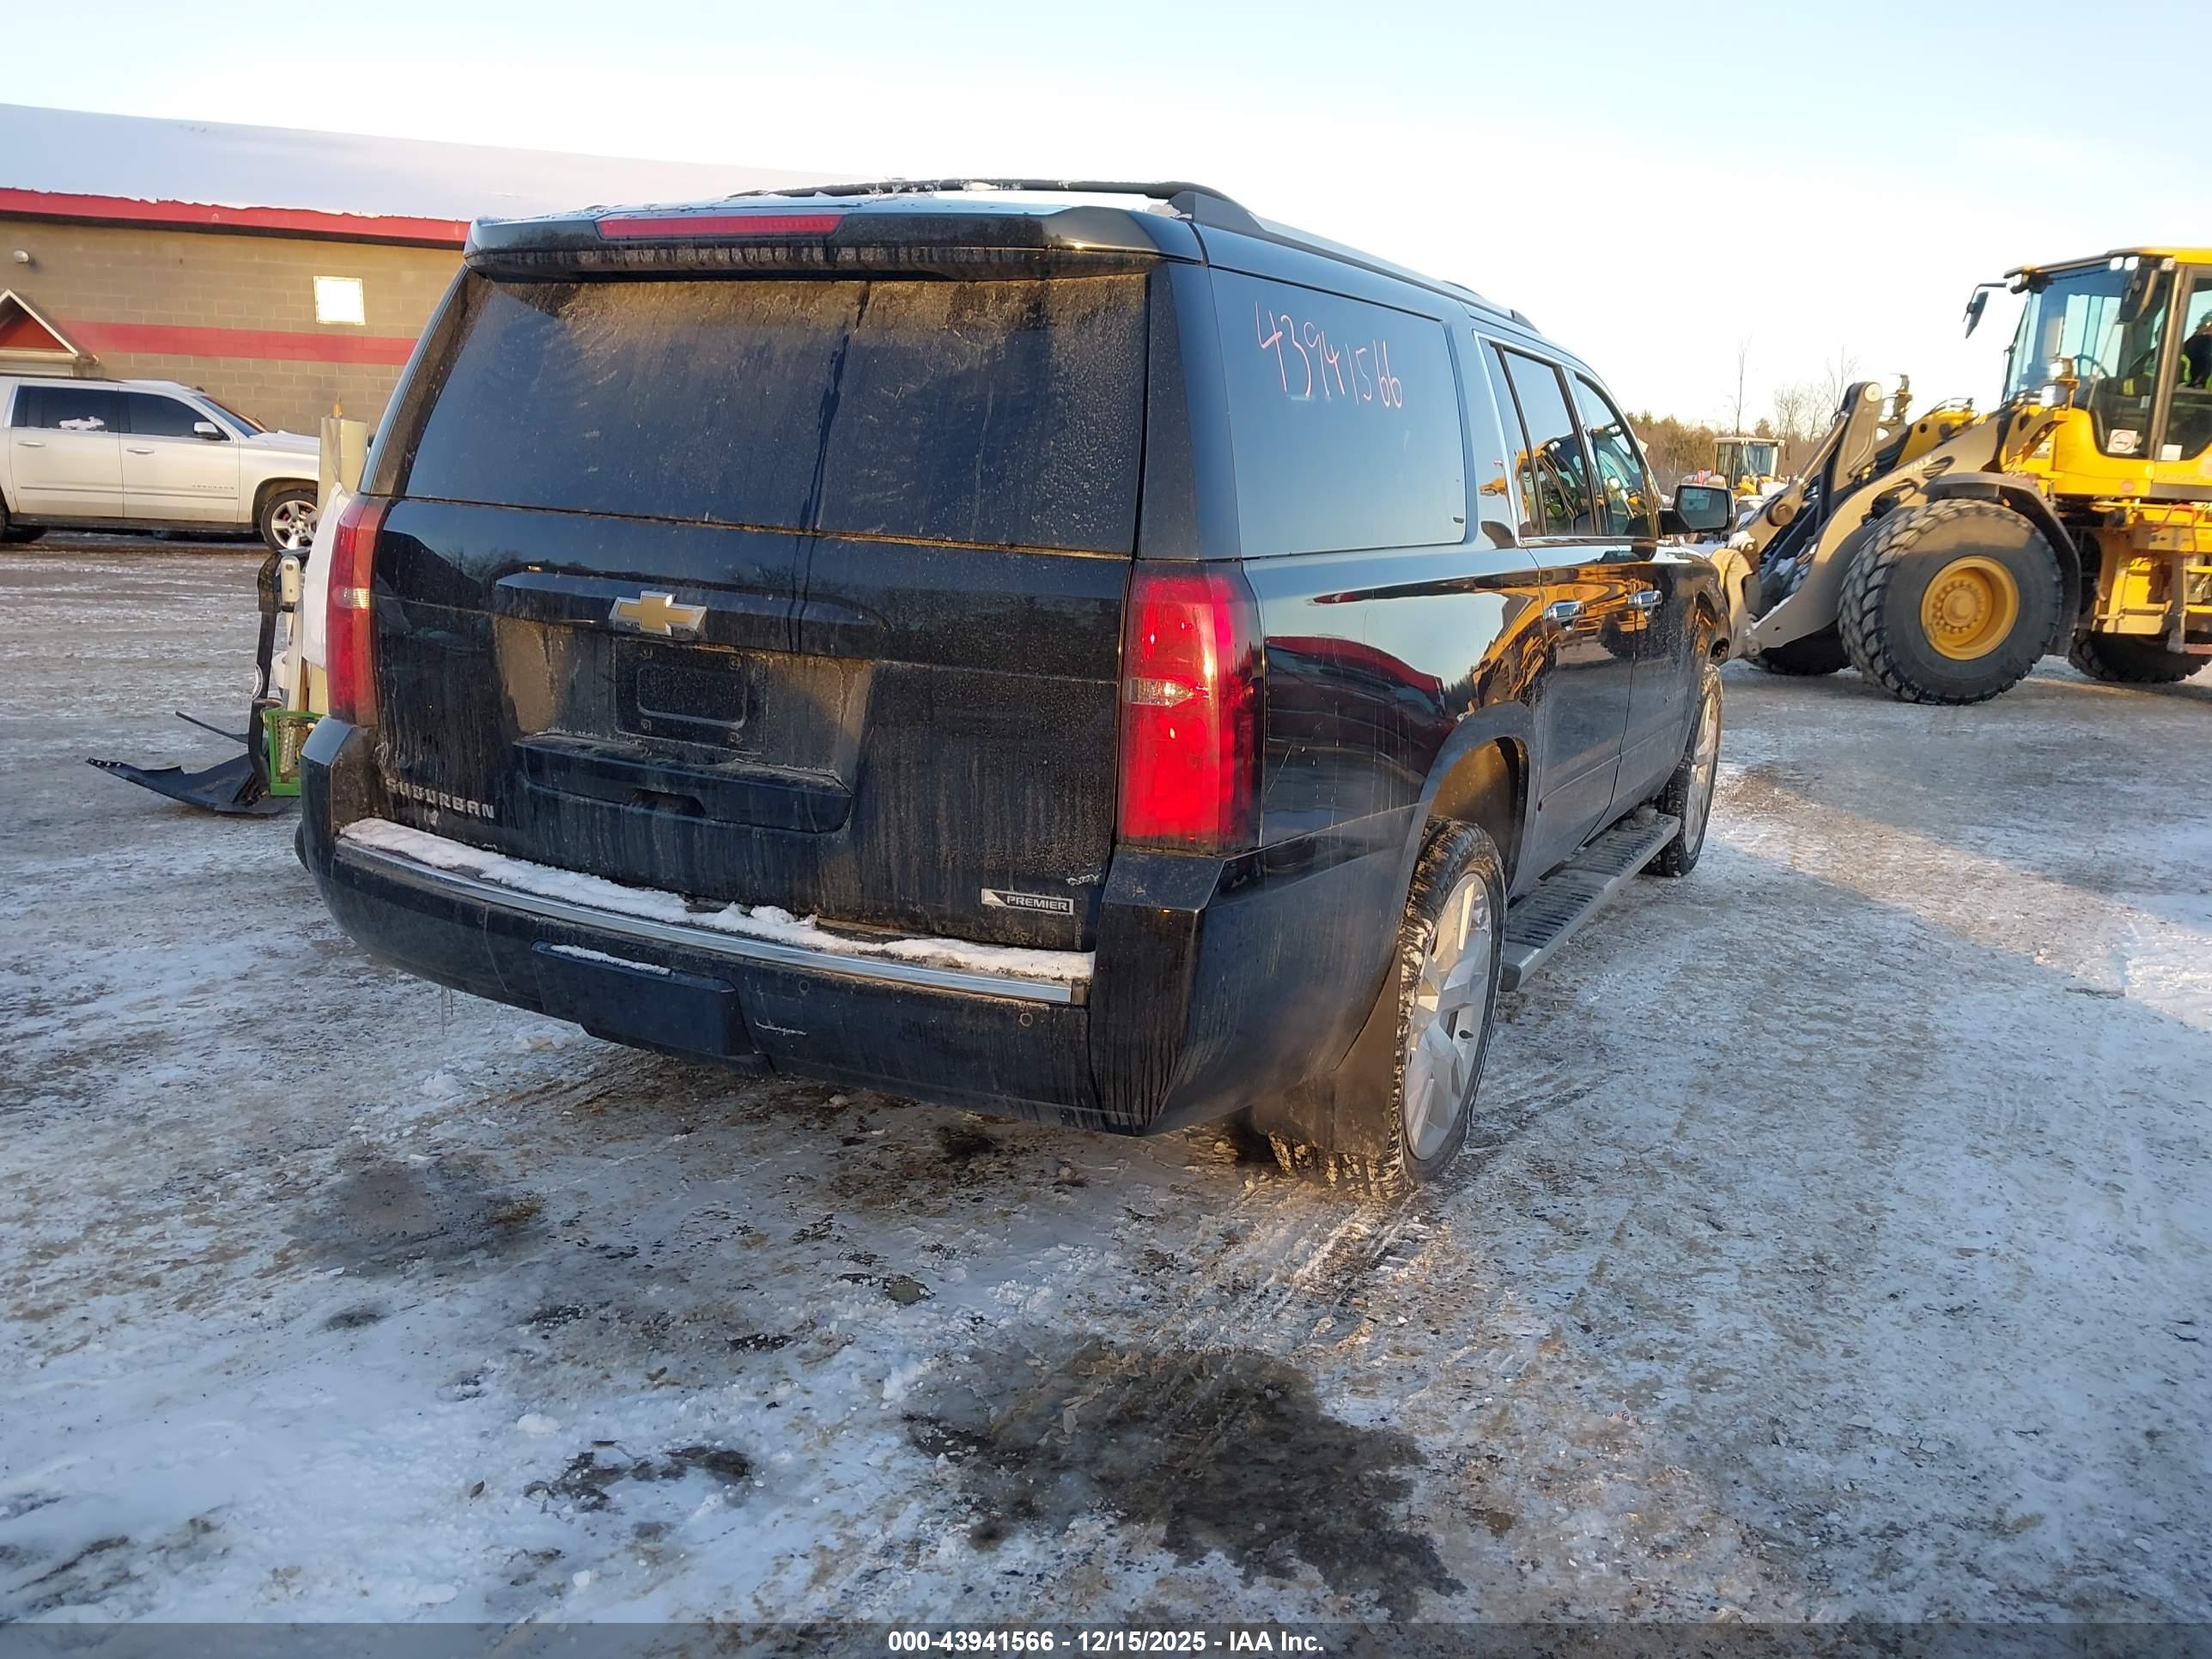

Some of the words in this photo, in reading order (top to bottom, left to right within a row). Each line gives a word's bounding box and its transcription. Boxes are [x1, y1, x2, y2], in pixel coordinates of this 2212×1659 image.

[1255, 301, 1403, 409] 43941566
[386, 777, 495, 819] SUBURBAN
[1006, 895, 1068, 911] PREMIER
